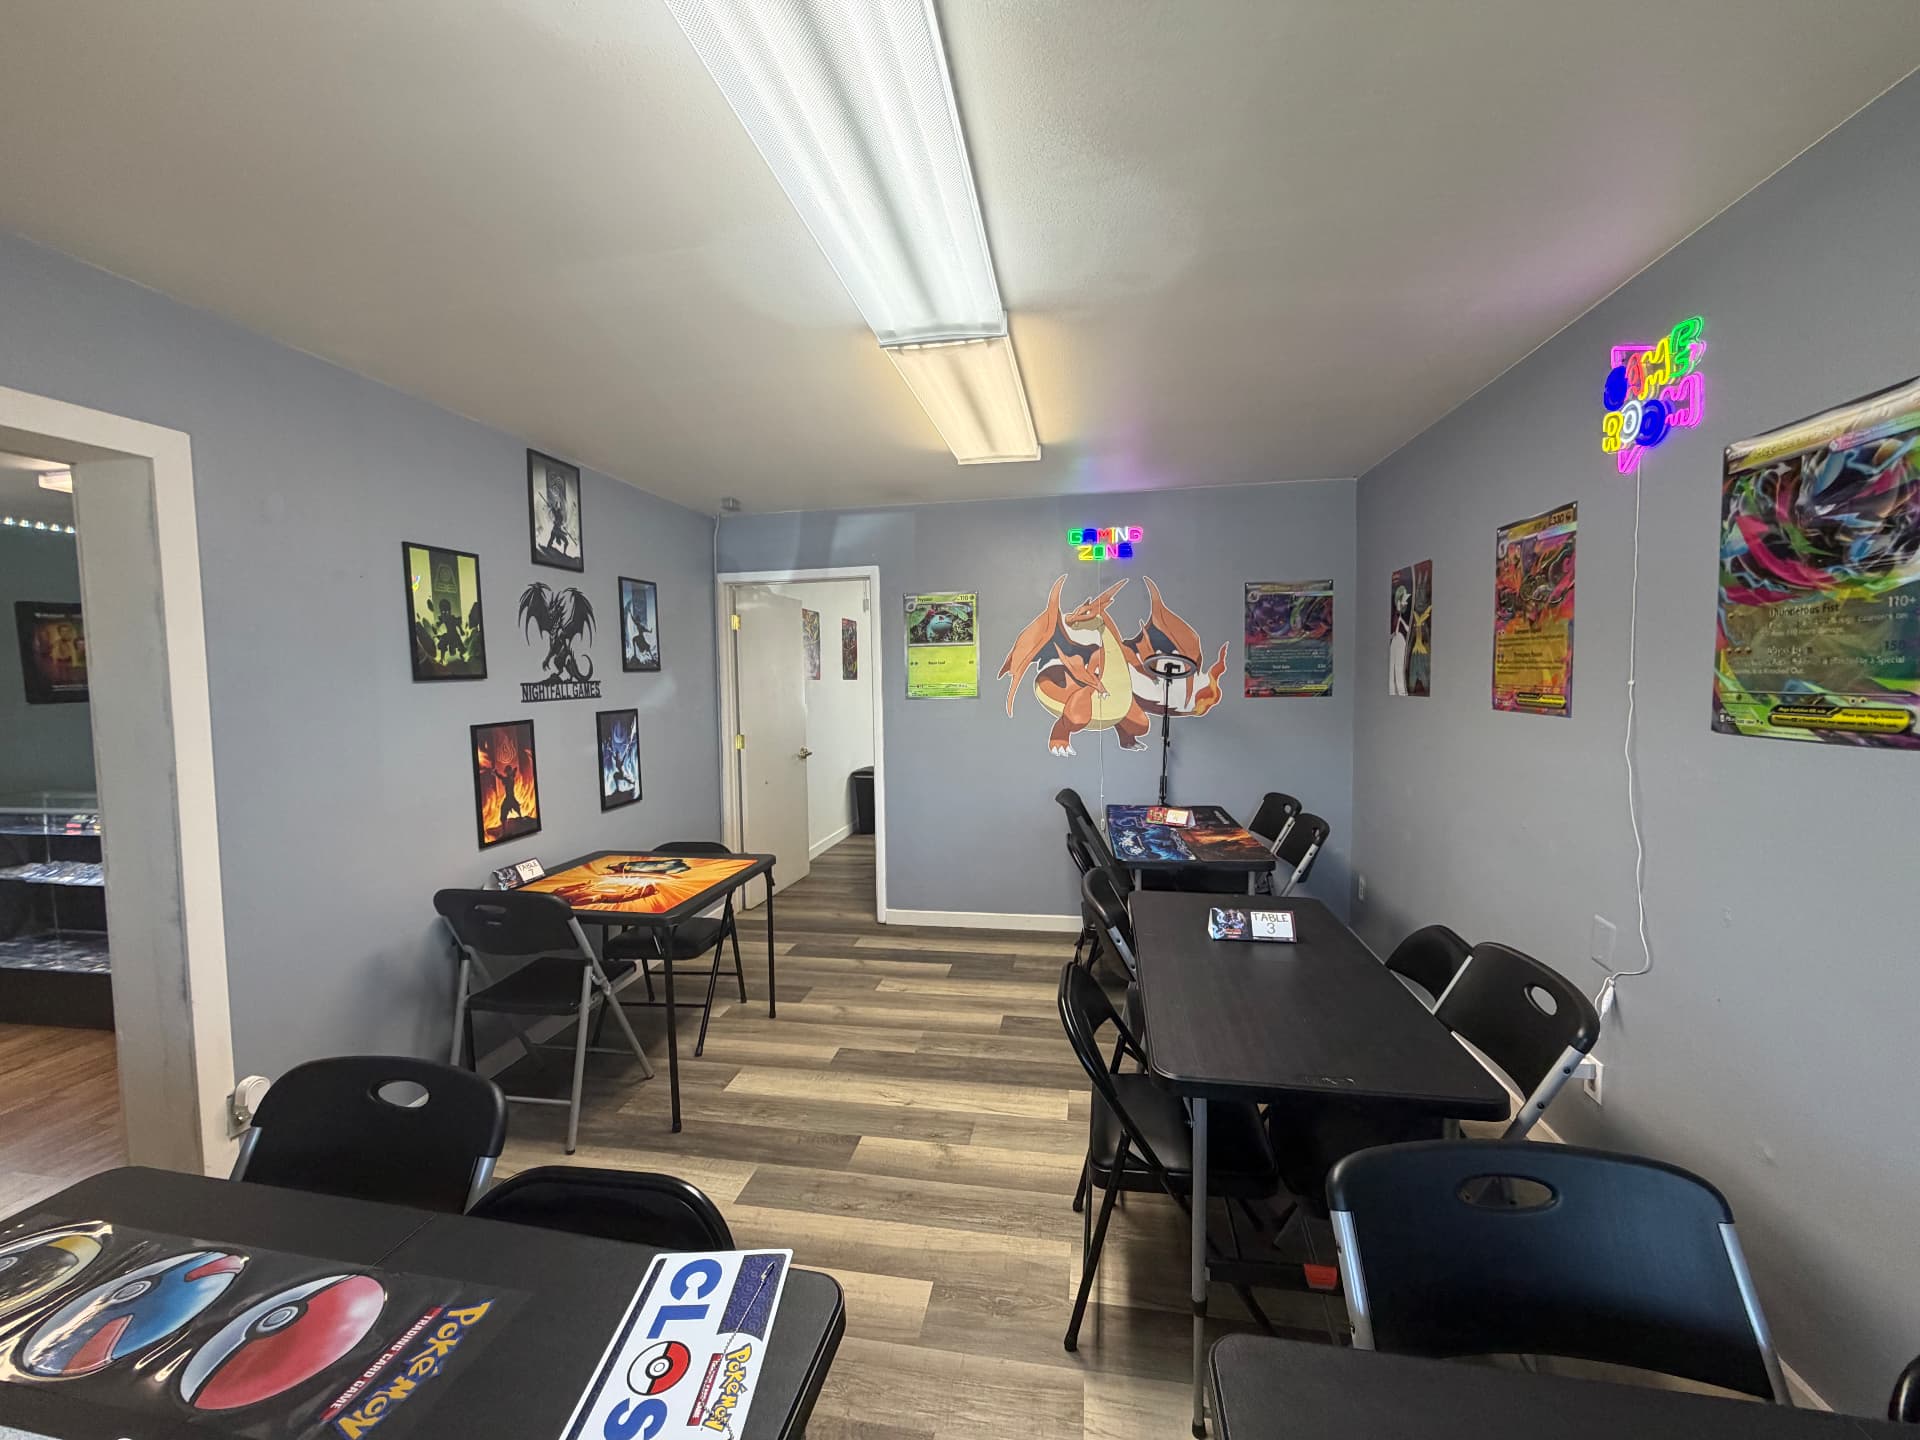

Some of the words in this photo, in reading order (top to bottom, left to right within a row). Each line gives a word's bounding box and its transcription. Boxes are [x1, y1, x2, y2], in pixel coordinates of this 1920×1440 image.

[1068, 526, 1143, 546] GAMING
[1078, 542, 1134, 561] ZONE
[521, 683, 571, 701] NIGHTFALL
[573, 681, 601, 699] GAMES
[1252, 912, 1289, 923] TABLE
[1266, 922, 1276, 935] 3
[391, 1314, 435, 1352] TRADING
[362, 1352, 394, 1379] CARD
[330, 1380, 366, 1410] GAME
